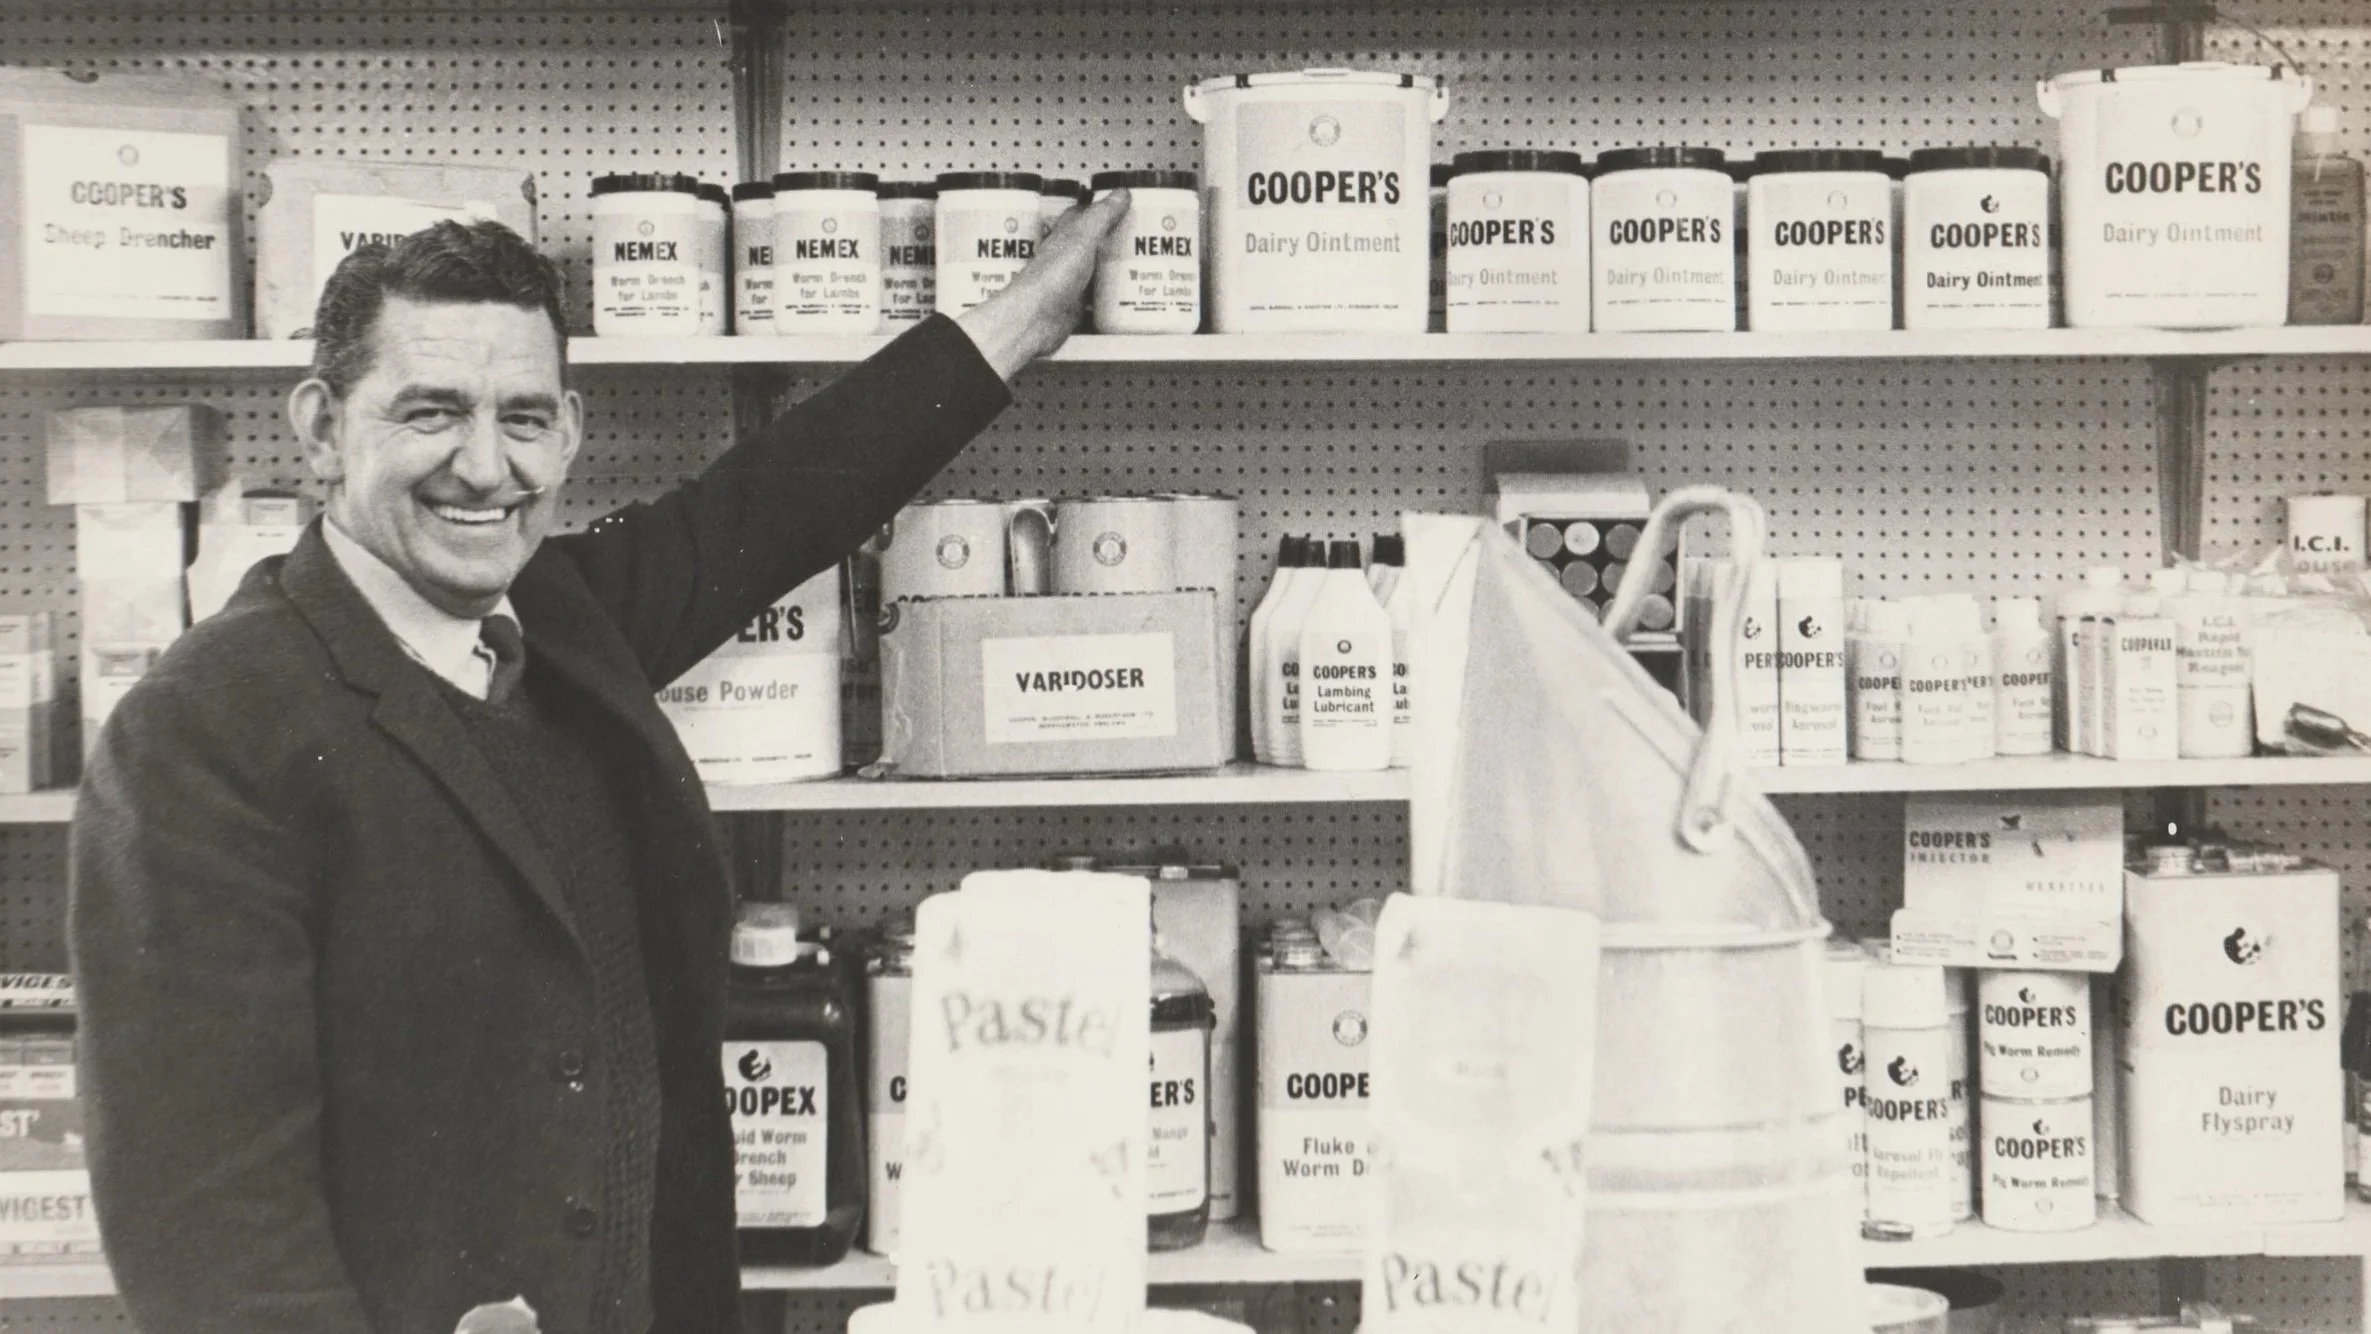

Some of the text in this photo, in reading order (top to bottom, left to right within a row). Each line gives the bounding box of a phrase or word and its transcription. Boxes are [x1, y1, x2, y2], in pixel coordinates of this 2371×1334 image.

[1248, 171, 1400, 205] COOPER'S
[2105, 161, 2261, 194] COOPER'S
[71, 181, 188, 209] COOPER'S
[120, 226, 216, 249] Drencher
[1449, 219, 1555, 247] COOPER'S
[1609, 216, 1721, 244] COOPER'S
[1774, 218, 1885, 246] COOPER'S
[1930, 222, 2041, 249] COOPER'S
[2103, 222, 2264, 247] Dairy Ointment
[615, 242, 678, 261] NEMEX
[796, 239, 859, 259] NEMEX
[977, 239, 1034, 258] NEMEX
[1134, 236, 1191, 257] NEMEX
[1245, 231, 1401, 257] Dairy Ointment
[1480, 269, 1558, 286] Ointment
[1607, 268, 1724, 286] Dairy Ointment
[1773, 268, 1817, 287] Dairy
[1926, 271, 1970, 290] Dairy
[2294, 535, 2349, 552] I.C.I.
[1016, 668, 1144, 693] VARIDOSER
[1313, 665, 1377, 679] COOPER'S
[720, 679, 799, 701] Powder
[1318, 685, 1371, 699] Lambing
[1313, 701, 1375, 713] Lubricant
[1910, 831, 1991, 848] COOPER'S
[1985, 1004, 2076, 1027] COOPER'S
[2165, 999, 2326, 1036] COOPER'S
[2218, 1085, 2277, 1109] Dairy
[2201, 1111, 2295, 1137] Flyspray
[761, 1130, 807, 1145] Worm
[1303, 1136, 1355, 1155] Fluke
[1995, 1136, 2086, 1159] COOPER'S
[1283, 1159, 1340, 1177] Worm
[748, 1172, 798, 1189] Sheep
